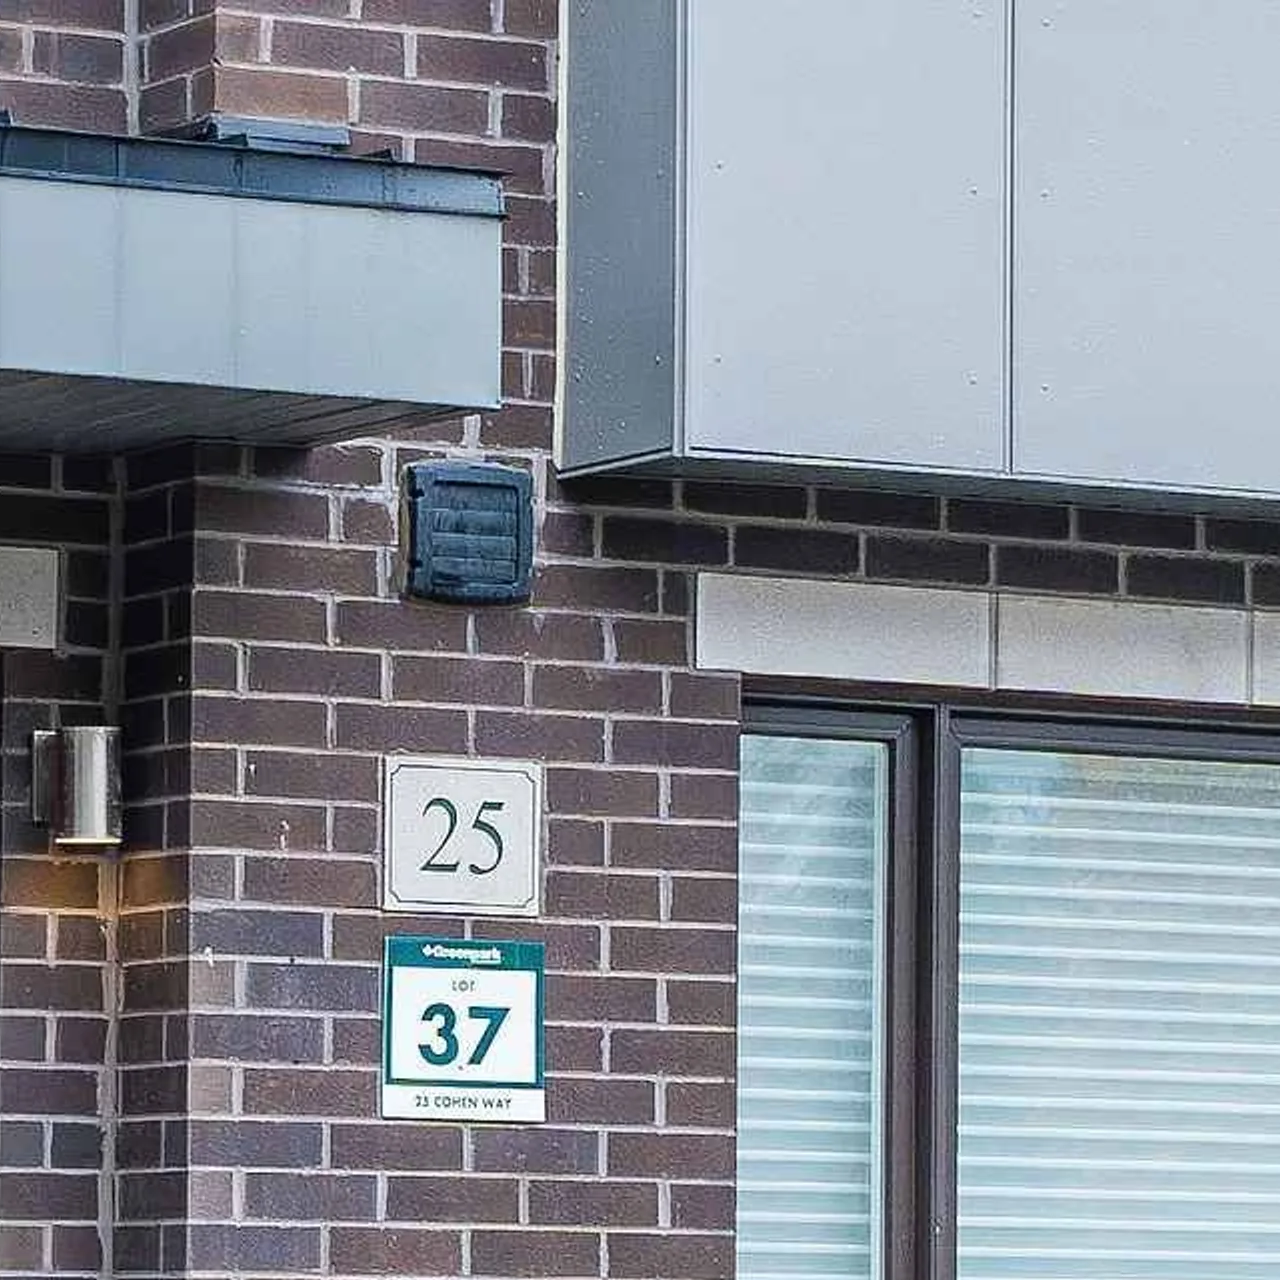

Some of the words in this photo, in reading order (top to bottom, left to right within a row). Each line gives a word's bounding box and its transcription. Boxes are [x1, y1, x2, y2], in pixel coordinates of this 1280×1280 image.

[420, 797, 506, 875] 25
[417, 1002, 510, 1067] 37
[482, 1097, 512, 1110] WAY
